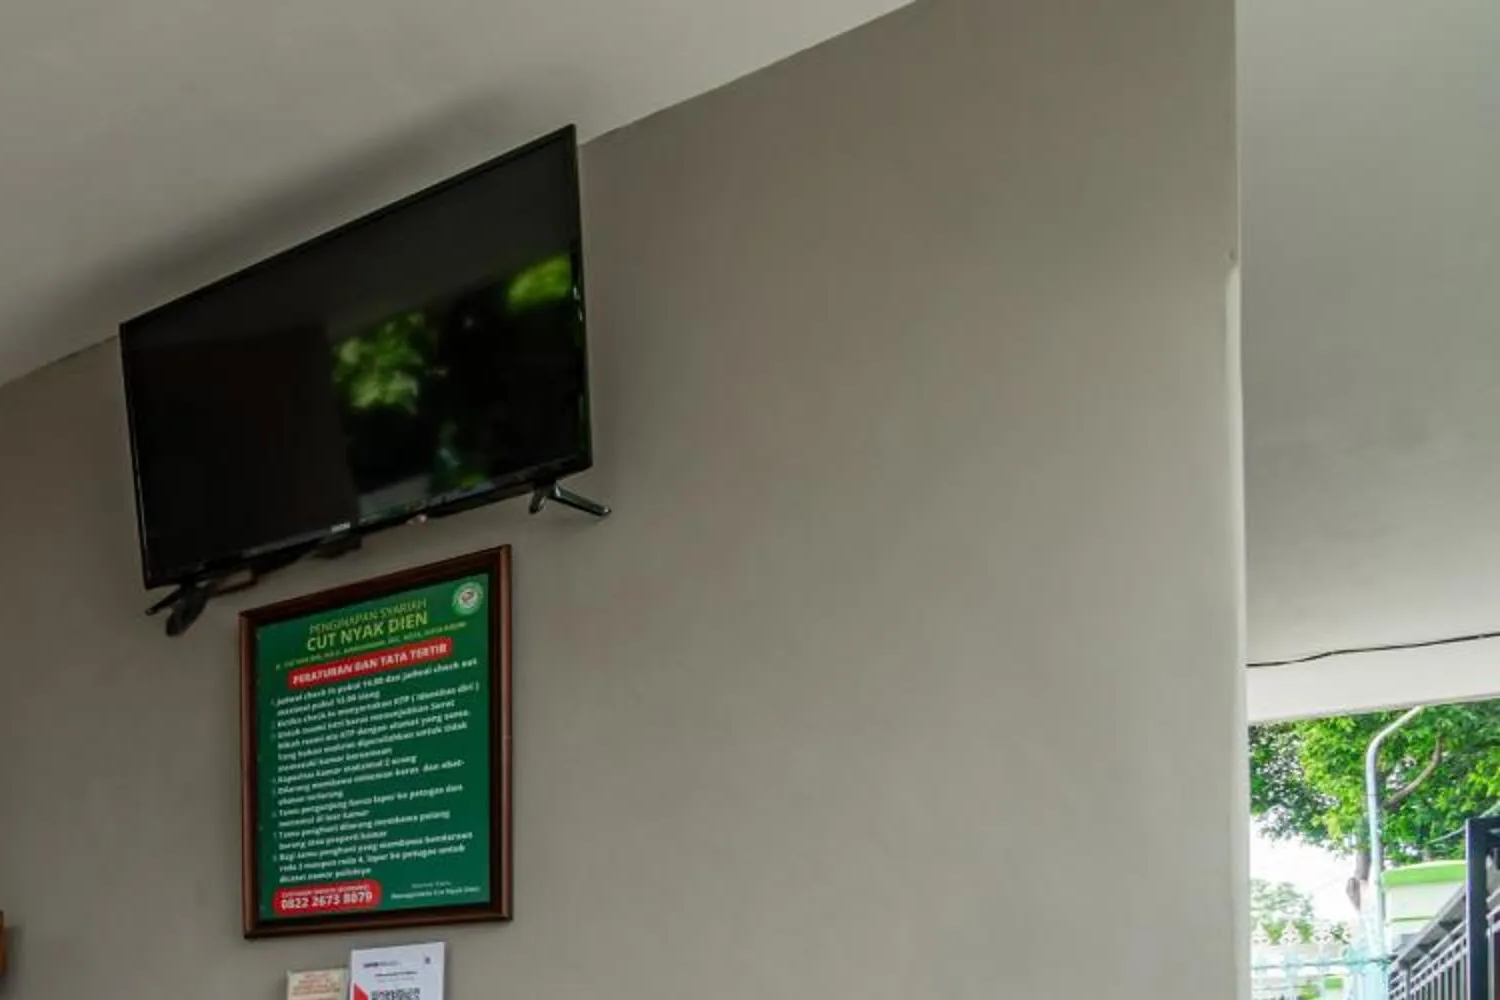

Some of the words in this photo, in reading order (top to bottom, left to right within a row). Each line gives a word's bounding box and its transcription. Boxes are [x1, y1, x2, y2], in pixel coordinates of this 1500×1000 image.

[307, 632, 336, 653] CUT
[341, 620, 384, 645] NYAK
[388, 611, 428, 634] DIEN
[380, 651, 408, 667] TATA
